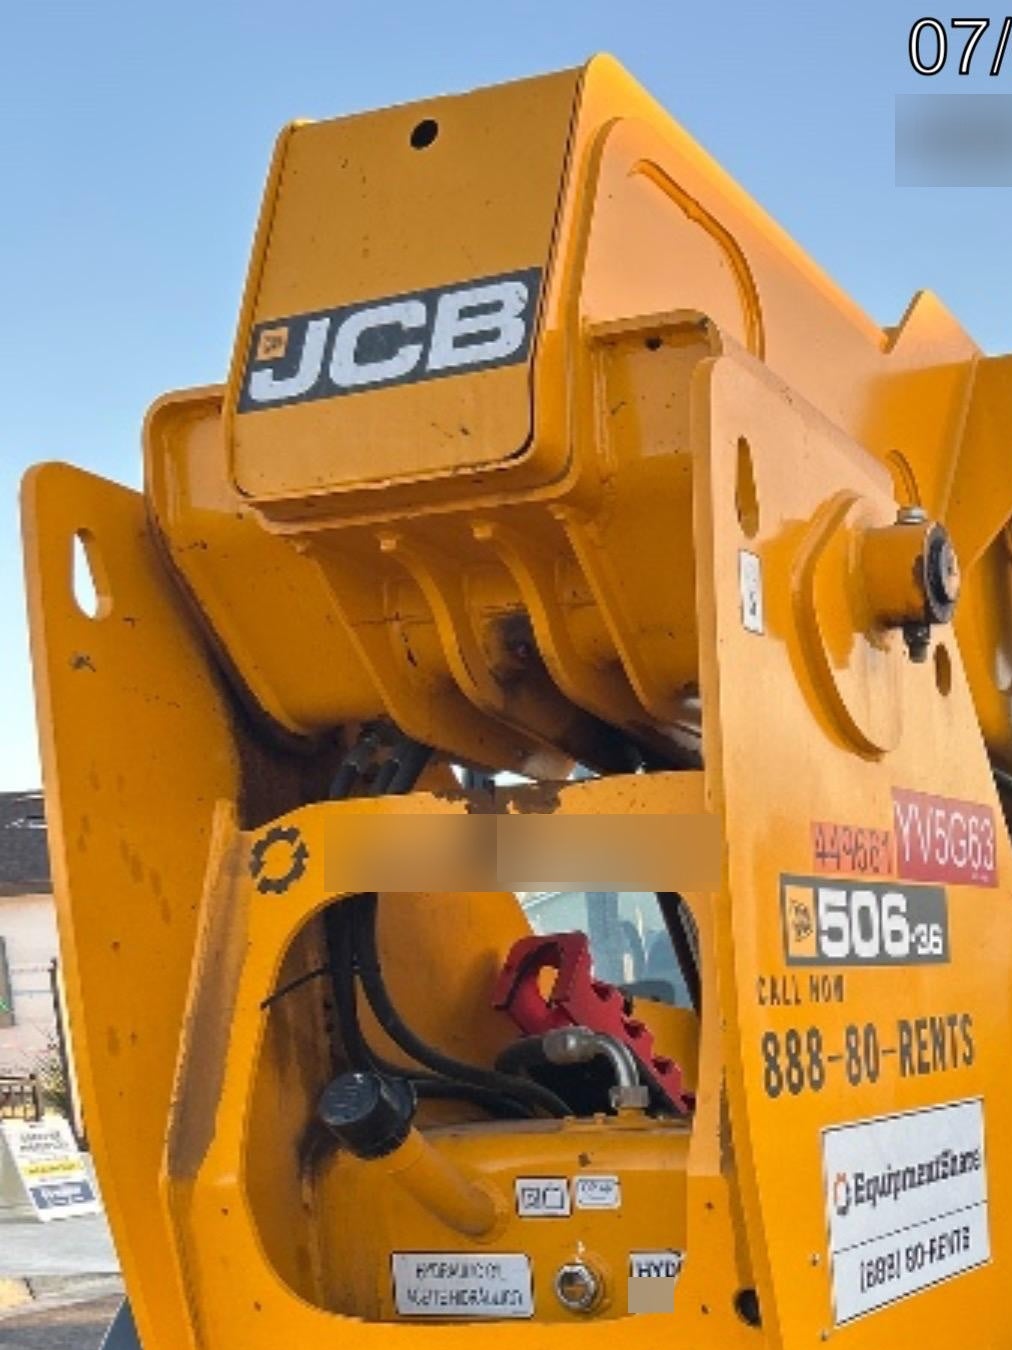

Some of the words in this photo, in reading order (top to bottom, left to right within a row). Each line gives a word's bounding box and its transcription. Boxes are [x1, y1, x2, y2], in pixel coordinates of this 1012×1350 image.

[249, 281, 528, 401] JCB
[757, 975, 801, 1006] CALL
[762, 1013, 976, 1098] 888-80-RENTS
